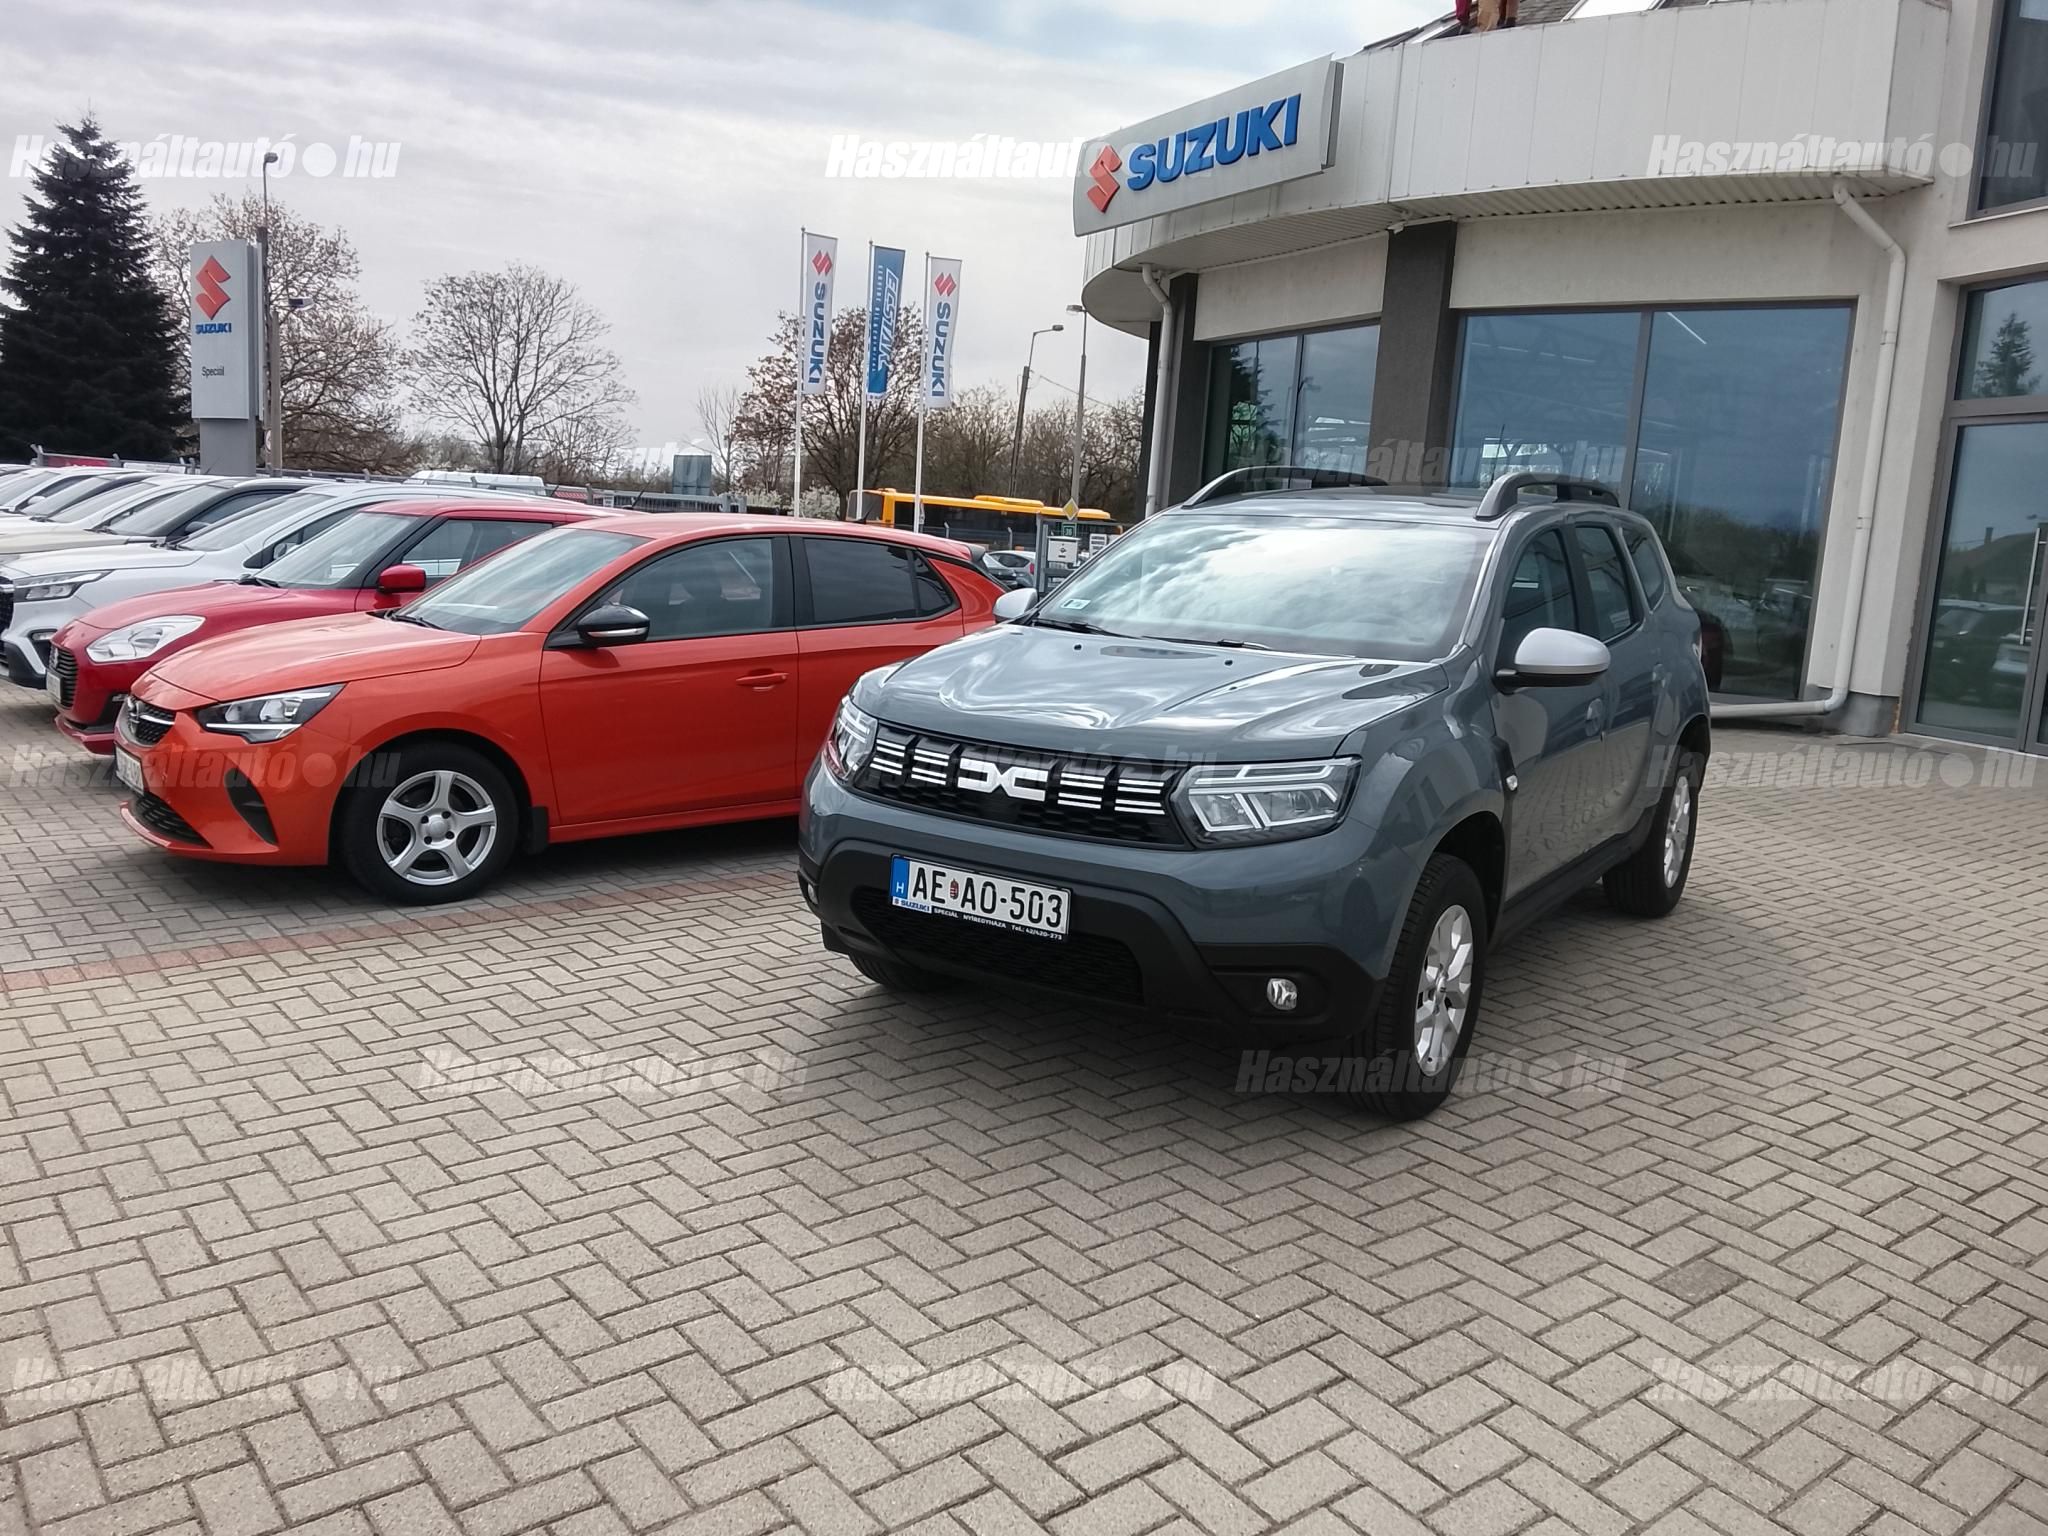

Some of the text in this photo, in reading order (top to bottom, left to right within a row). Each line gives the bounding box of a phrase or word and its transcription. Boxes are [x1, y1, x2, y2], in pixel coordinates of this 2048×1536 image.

[1127, 93, 1301, 191] SUZUKI
[195, 322, 232, 334] SUZUKI
[808, 281, 826, 384] SUZUKI
[878, 267, 900, 372] ECSTAR
[931, 301, 951, 397] SUZUKI
[896, 881, 904, 894] H
[900, 899, 930, 912] SUZUKI
[912, 867, 946, 904] AE
